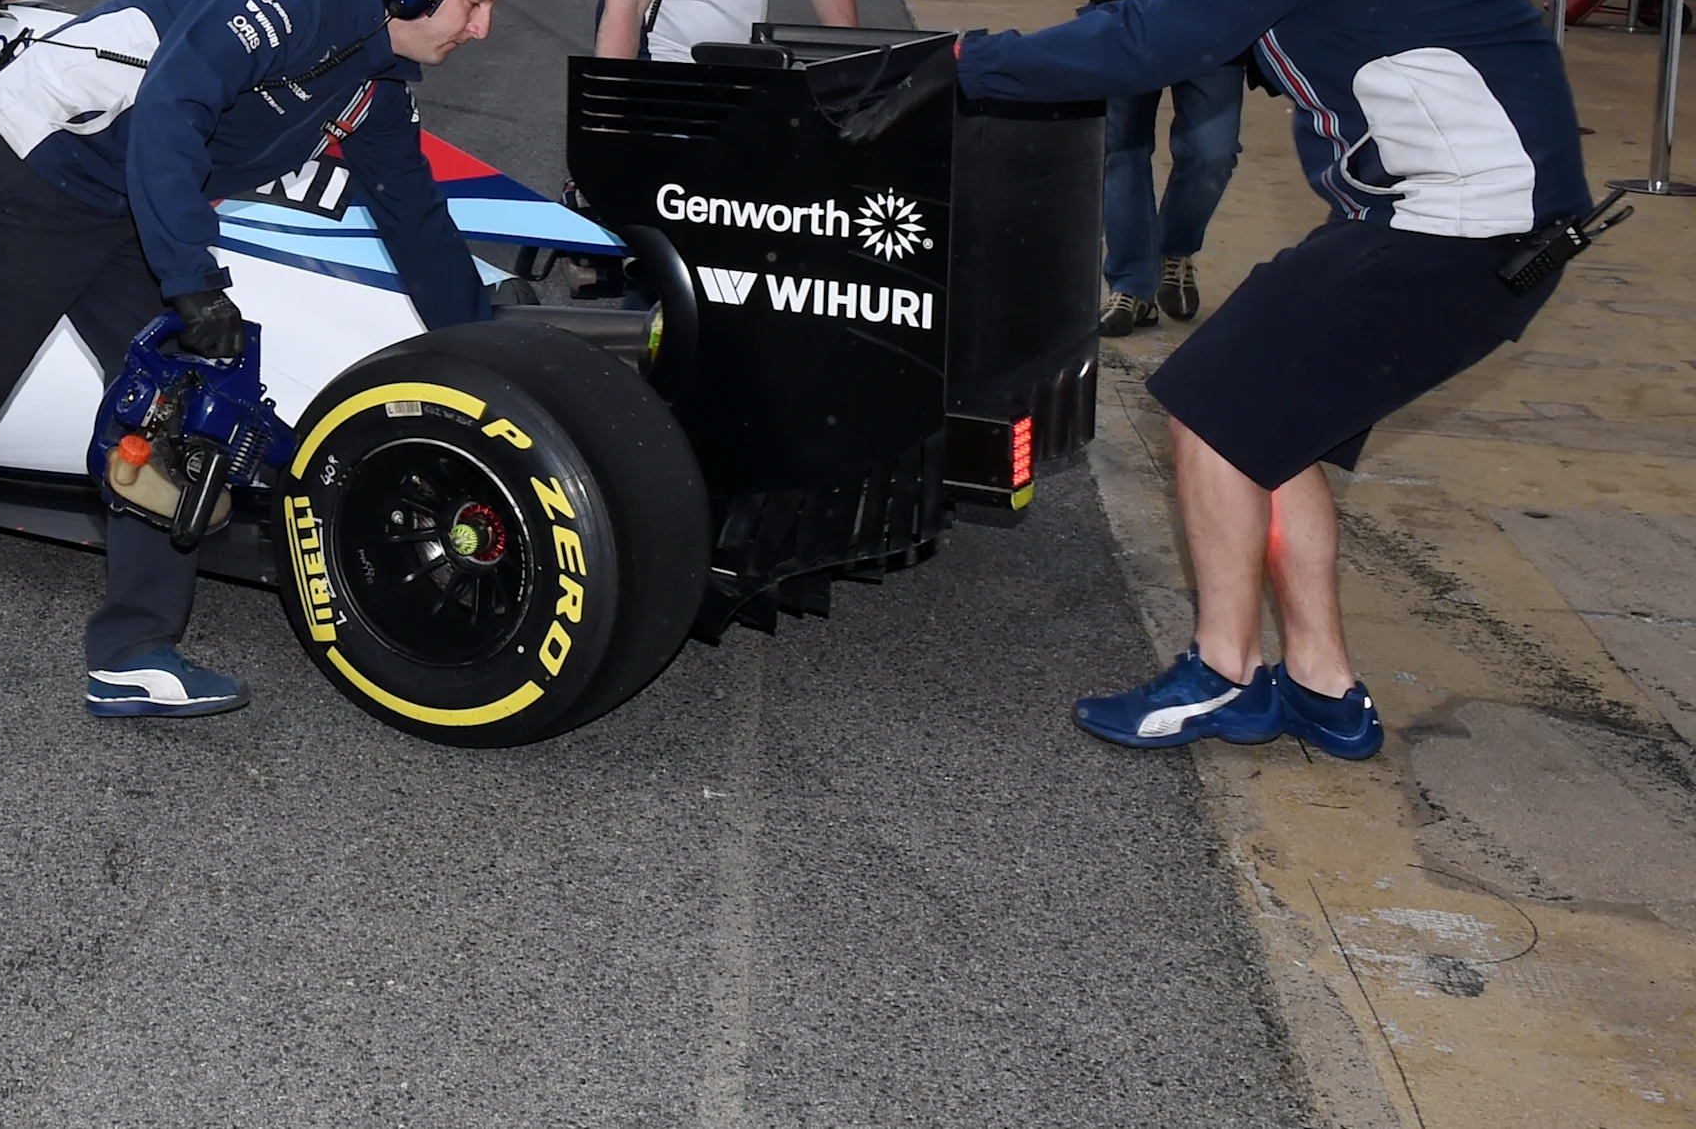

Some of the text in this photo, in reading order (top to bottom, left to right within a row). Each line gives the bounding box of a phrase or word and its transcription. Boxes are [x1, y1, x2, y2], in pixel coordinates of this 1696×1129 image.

[232, 15, 261, 50] ORIS
[255, 10, 281, 48] WIHURI
[656, 183, 850, 238] Genworth
[765, 274, 933, 330] WIHURI
[284, 495, 338, 642] PIRELLI
[481, 418, 587, 677] P ZERO
